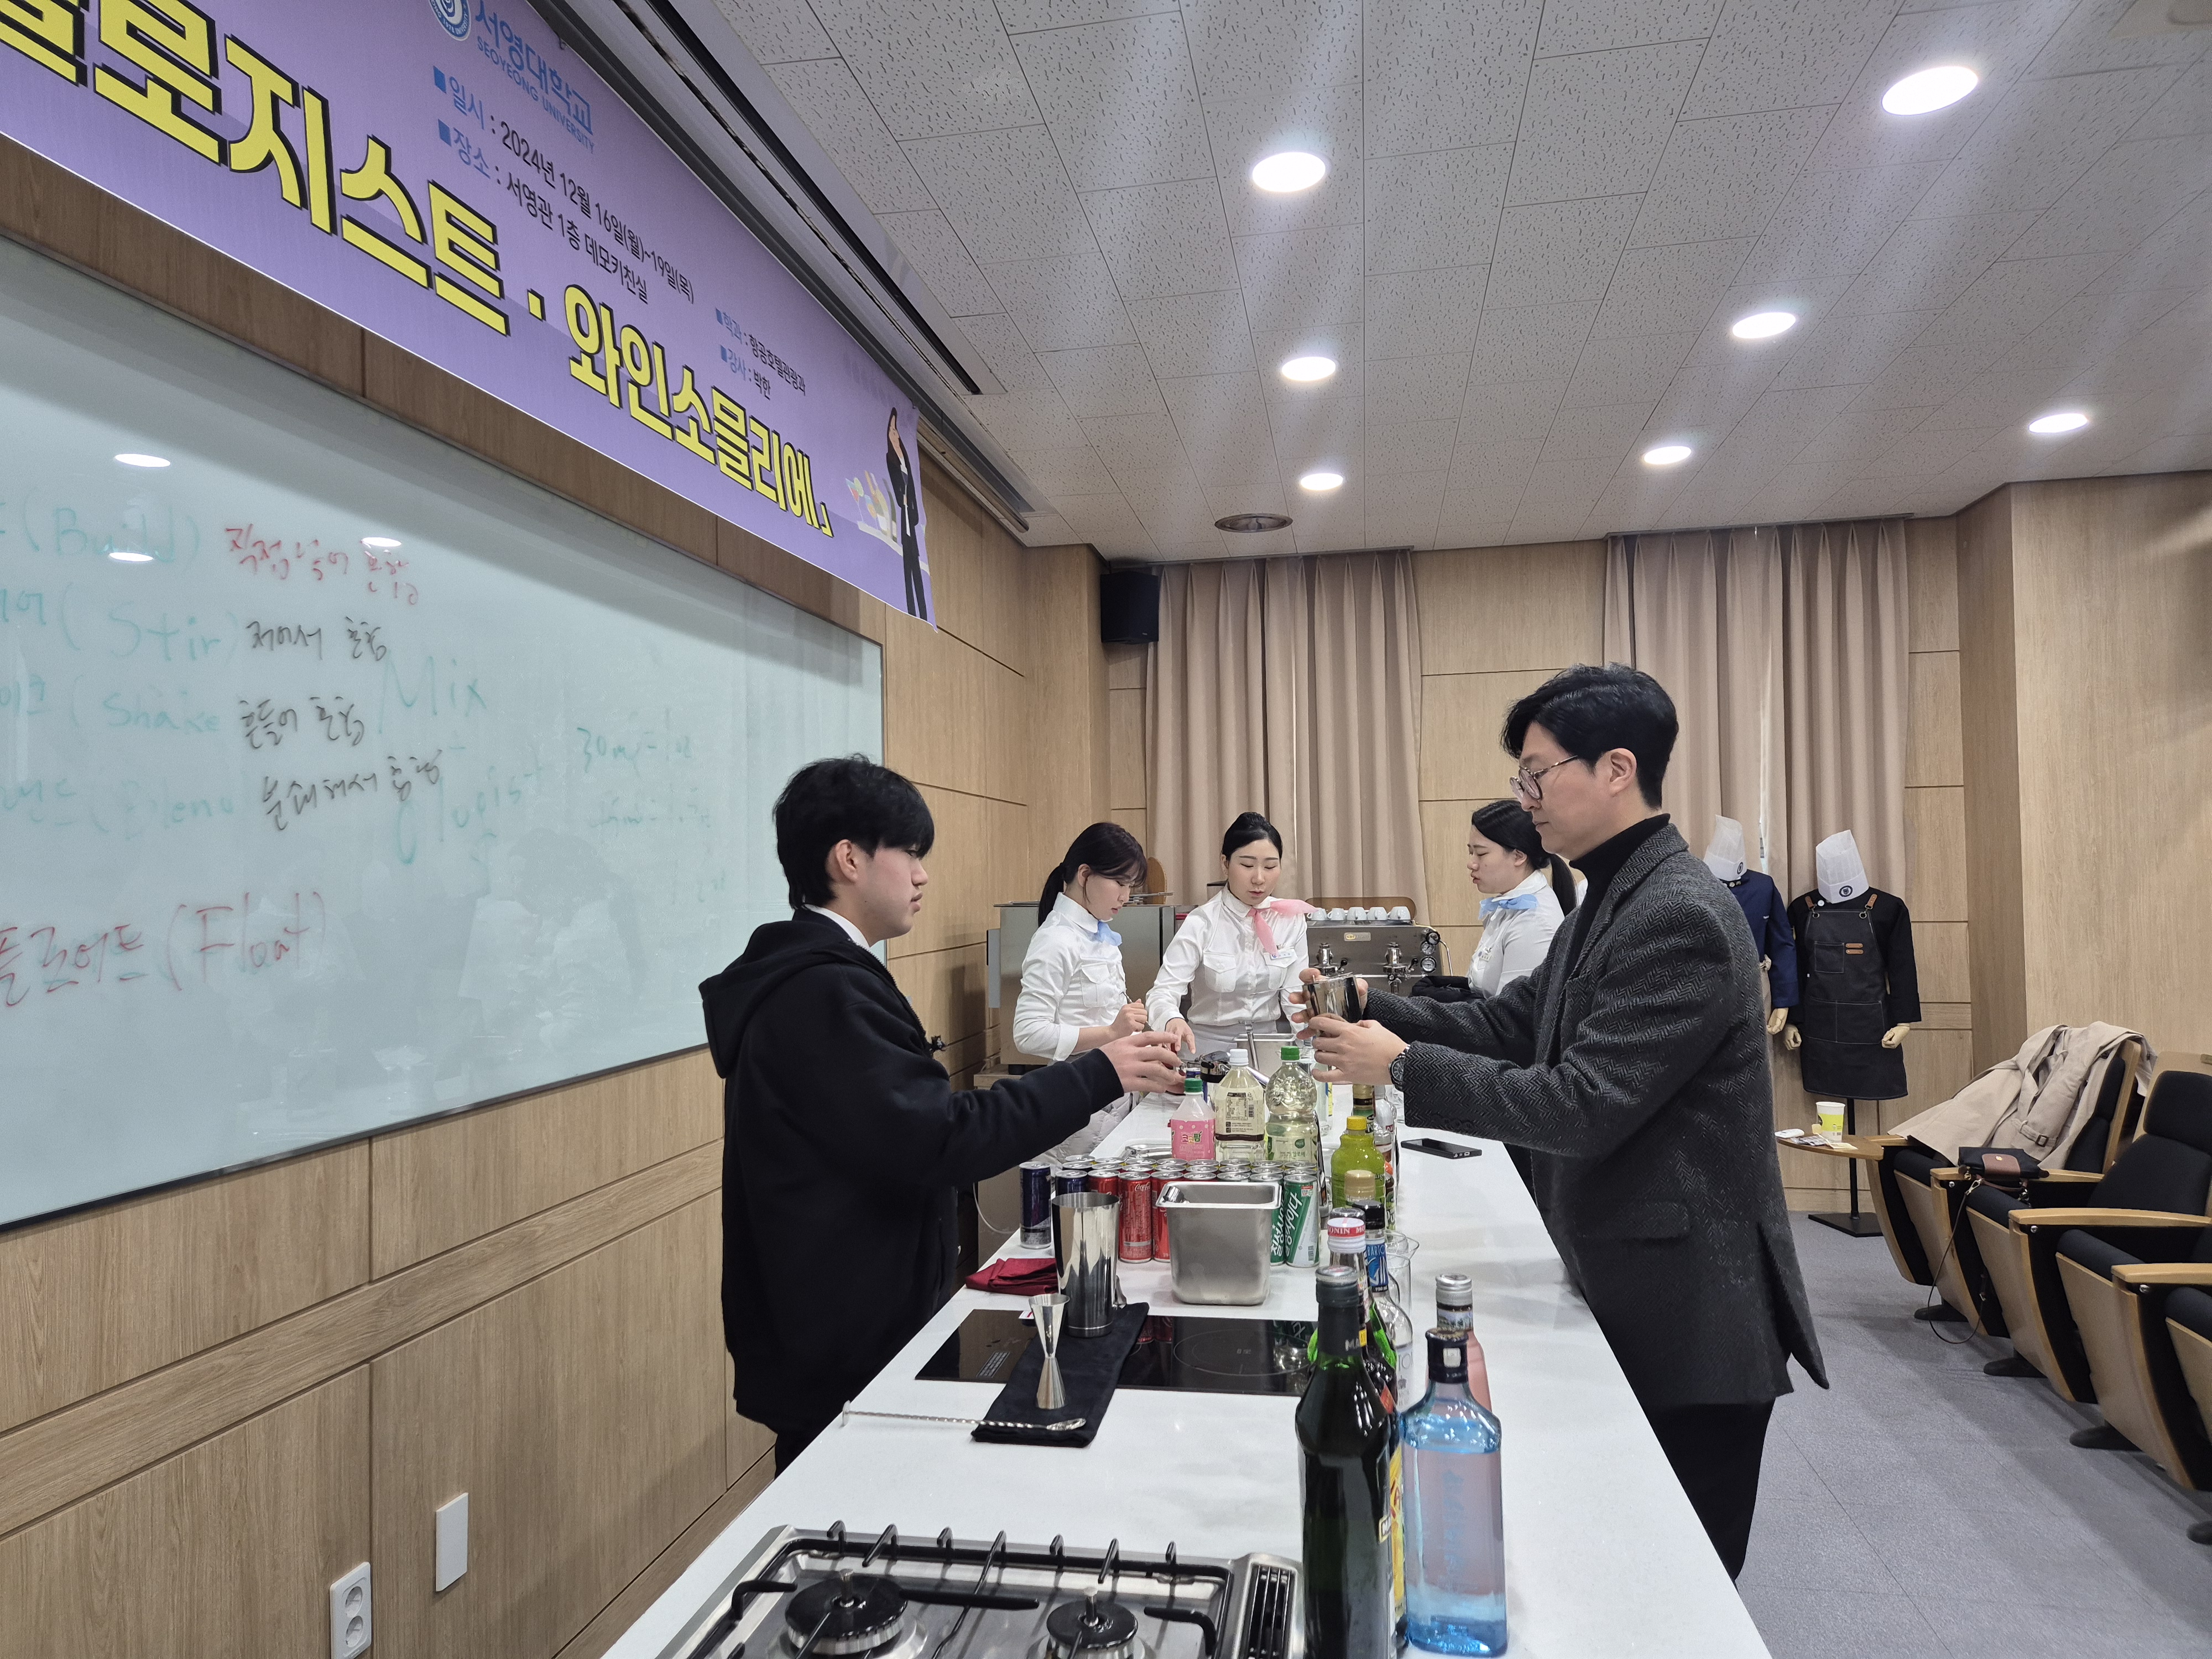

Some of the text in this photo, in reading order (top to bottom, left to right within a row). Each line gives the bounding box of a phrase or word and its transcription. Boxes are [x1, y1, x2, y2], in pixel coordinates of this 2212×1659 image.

[476, 0, 594, 135] 서영대학교
[477, 36, 594, 154] SEOYEONG UNIVERSITY
[450, 76, 484, 130] 일시
[500, 121, 556, 189] 2024년
[560, 173, 592, 220] 12월
[453, 127, 491, 179] 장소
[507, 172, 553, 231] 서영관
[558, 213, 580, 251] 1층
[585, 233, 648, 305] 데모키친실
[749, 334, 806, 397] 항공호텔관광과
[753, 369, 771, 401] 박한
